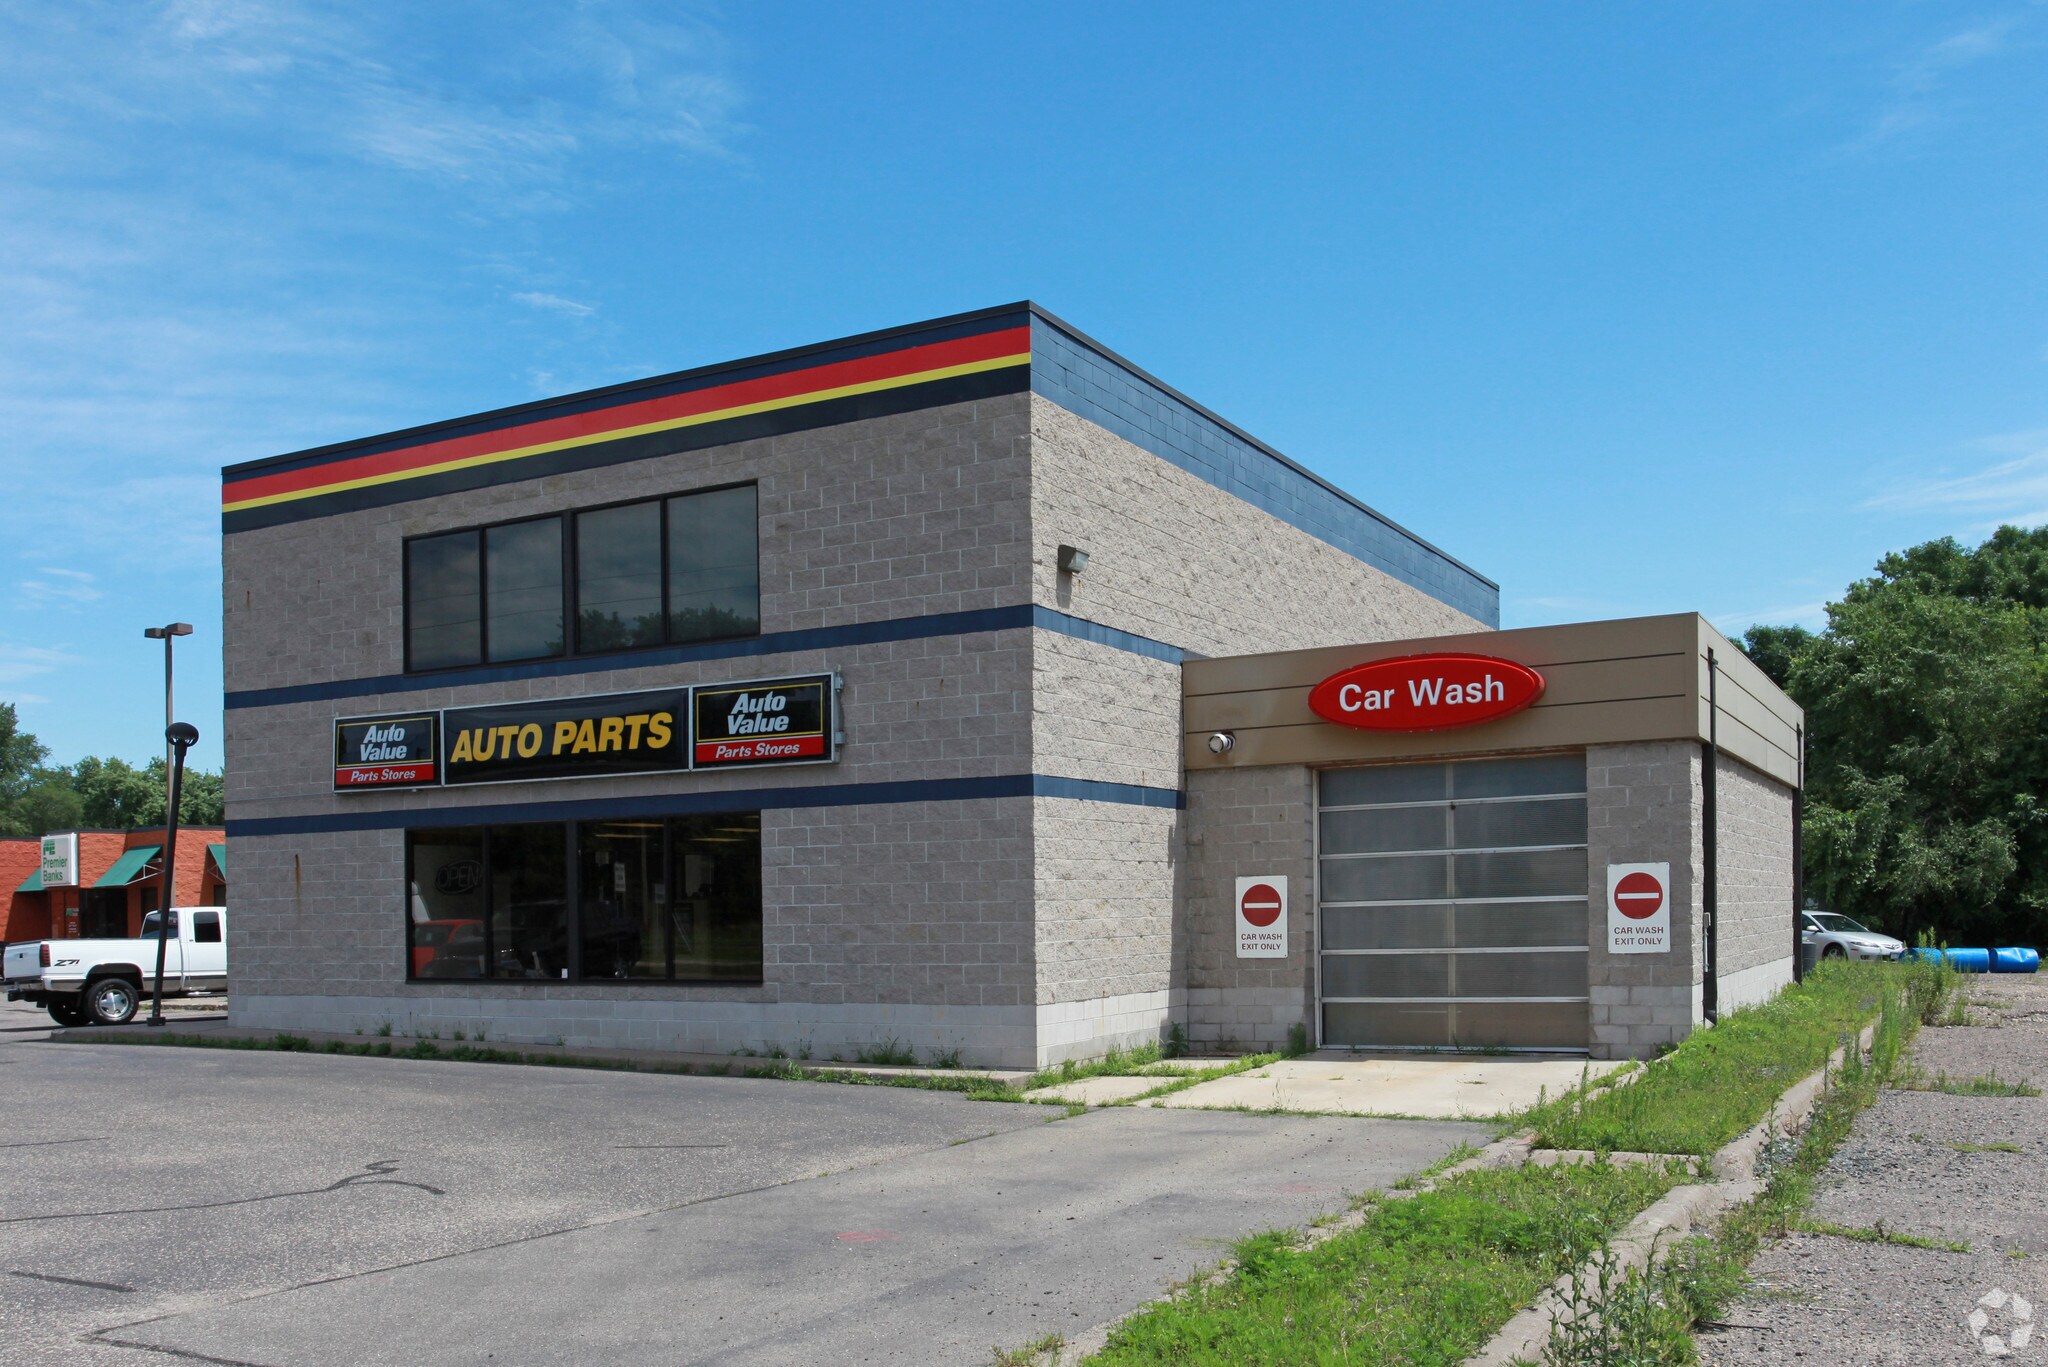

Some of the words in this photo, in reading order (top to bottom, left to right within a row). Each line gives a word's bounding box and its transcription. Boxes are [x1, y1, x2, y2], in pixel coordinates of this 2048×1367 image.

[730, 690, 787, 715] Auto
[1338, 683, 1395, 712] Car
[1407, 674, 1504, 707] Wash
[362, 723, 405, 744] Auto
[727, 713, 790, 735] Value
[450, 723, 543, 763] AUTO
[551, 712, 673, 756] PARTS
[360, 741, 408, 762] Value
[715, 745, 752, 759] Parts
[754, 742, 800, 757] Stores
[350, 770, 379, 783] Parts
[381, 768, 416, 781] Stores
[43, 856, 68, 869] Premier
[43, 870, 63, 882] Banks
[438, 864, 479, 888] OPEN
[1614, 927, 1633, 935] CAR
[1635, 926, 1664, 934] WASH
[1614, 937, 1635, 945] EXIT
[1637, 937, 1663, 945] ONLY
[54, 959, 81, 967] Z71
